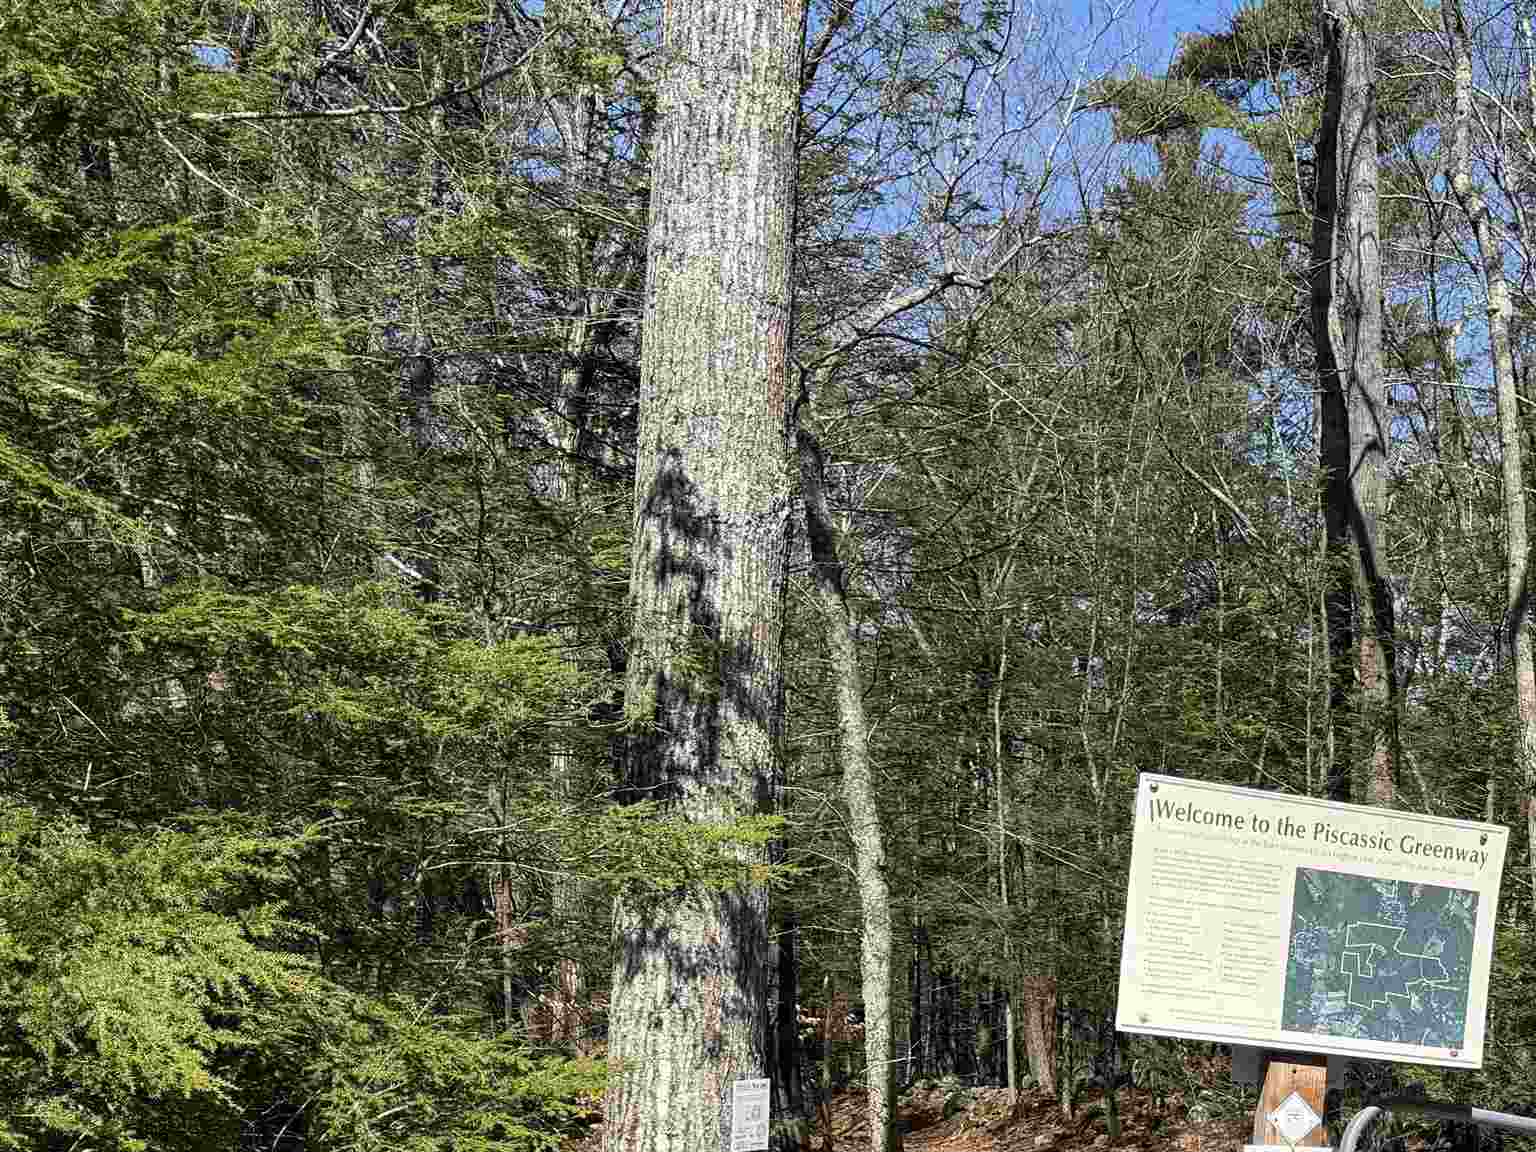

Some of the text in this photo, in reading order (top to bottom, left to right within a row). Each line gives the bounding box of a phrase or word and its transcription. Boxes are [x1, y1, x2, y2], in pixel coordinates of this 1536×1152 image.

[1156, 798, 1245, 830] Welcome
[1251, 812, 1270, 833] to
[1277, 816, 1306, 839] the
[1313, 822, 1393, 852] Piscassic
[1399, 834, 1489, 871] Greenway
